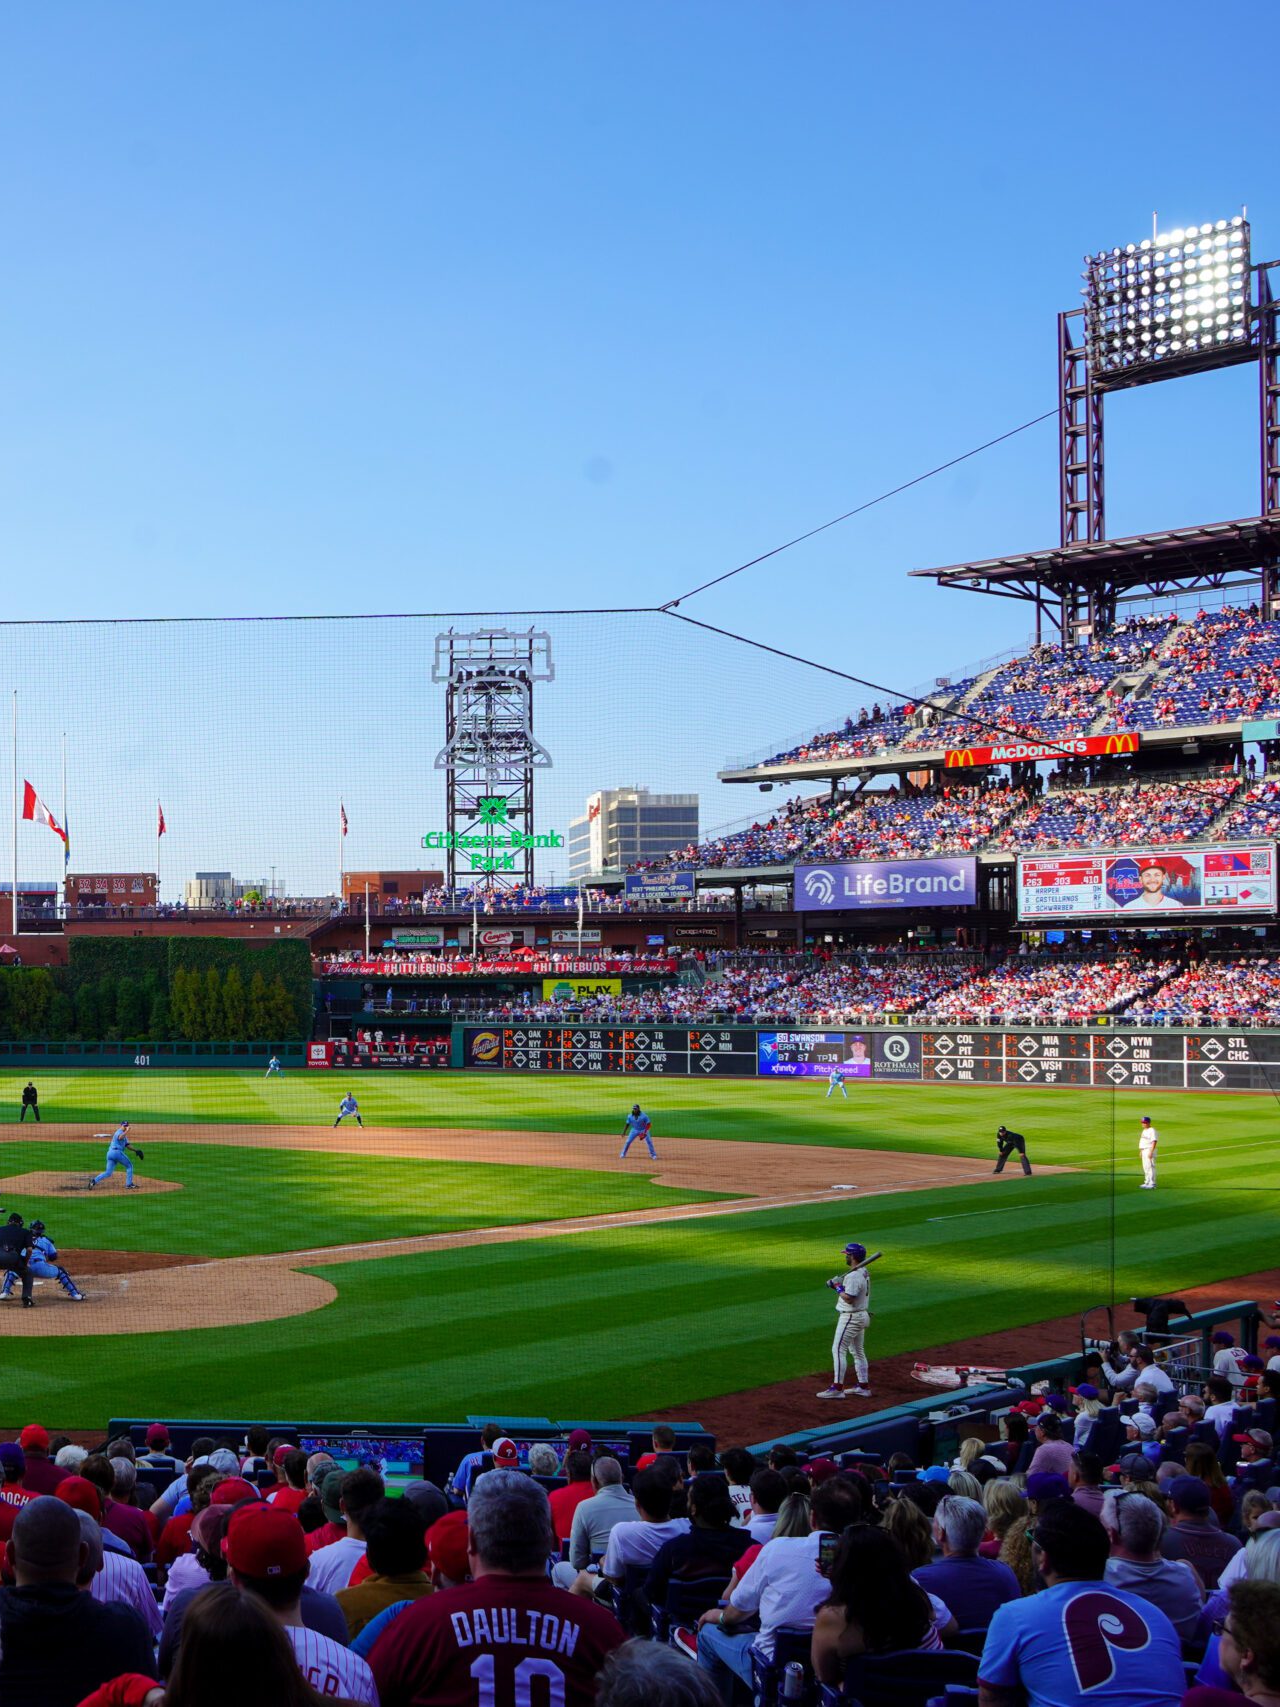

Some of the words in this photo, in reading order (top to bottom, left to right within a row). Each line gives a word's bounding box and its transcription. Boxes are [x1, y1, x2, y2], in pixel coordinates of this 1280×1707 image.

[990, 740, 1087, 760] McDonald's
[425, 831, 506, 848] Citizens
[510, 830, 562, 848] Bank
[470, 853, 514, 870] Park
[844, 869, 965, 896] LifeBrand
[325, 963, 375, 974] Budweiser
[384, 962, 454, 974] #HITTHEBUDS
[468, 962, 519, 974] Budweiser
[533, 962, 607, 973] #HITTHEBUDS
[528, 1030, 541, 1038] OAK
[589, 1031, 601, 1039] TEX
[720, 1033, 730, 1041] SD
[789, 1033, 826, 1043] SWANSON
[956, 1034, 974, 1044] COL
[528, 1039, 541, 1047] NYY
[589, 1041, 602, 1049] SEA
[1042, 1036, 1059, 1045] MIA
[1130, 1037, 1152, 1047] NYM
[1228, 1038, 1247, 1048] STL
[652, 1042, 665, 1050] BAL
[719, 1043, 732, 1051] MIN
[958, 1046, 972, 1055] PIT
[1043, 1048, 1058, 1057] ARI
[1133, 1049, 1150, 1059] CIN
[1227, 1051, 1249, 1061] CHC
[134, 1055, 151, 1066] 401
[957, 1059, 974, 1068] LAD
[589, 1062, 601, 1070] LAA
[653, 1064, 663, 1072] KC
[771, 1063, 797, 1074] xfinity
[1040, 1061, 1062, 1071] WSH
[1131, 1063, 1152, 1072] BOS
[958, 1071, 974, 1080] MIL
[1045, 1073, 1056, 1082] SF
[1132, 1075, 1150, 1085] ATL
[450, 1608, 580, 1657] DAULTON
[470, 1653, 566, 1707] 10
